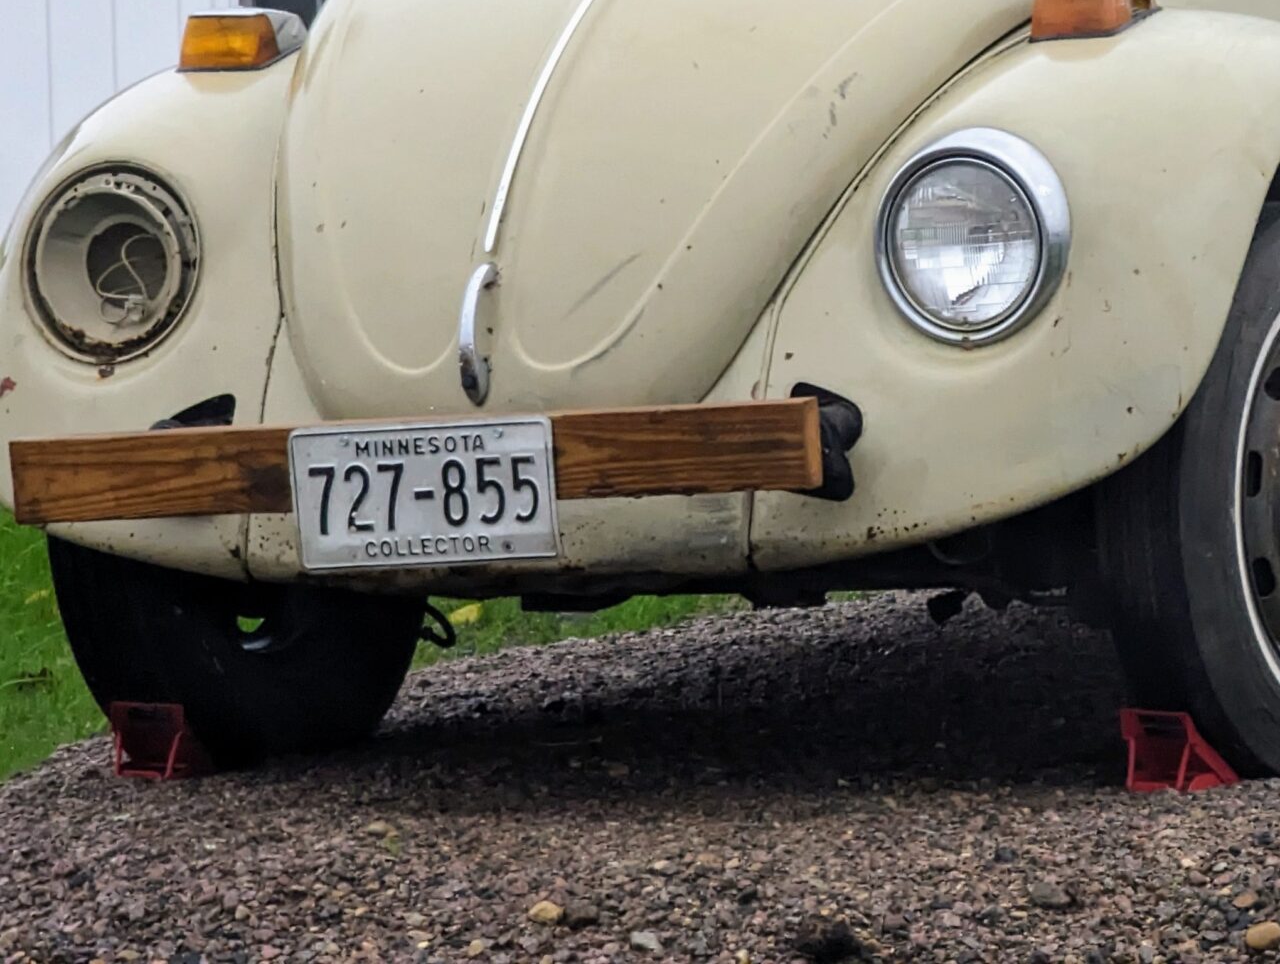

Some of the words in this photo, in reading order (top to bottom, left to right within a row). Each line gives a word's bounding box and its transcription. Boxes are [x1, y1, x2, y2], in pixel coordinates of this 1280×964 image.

[355, 434, 485, 457] MINNESOTA
[308, 454, 540, 536] 727-855
[365, 536, 492, 558] COLLECTOR
